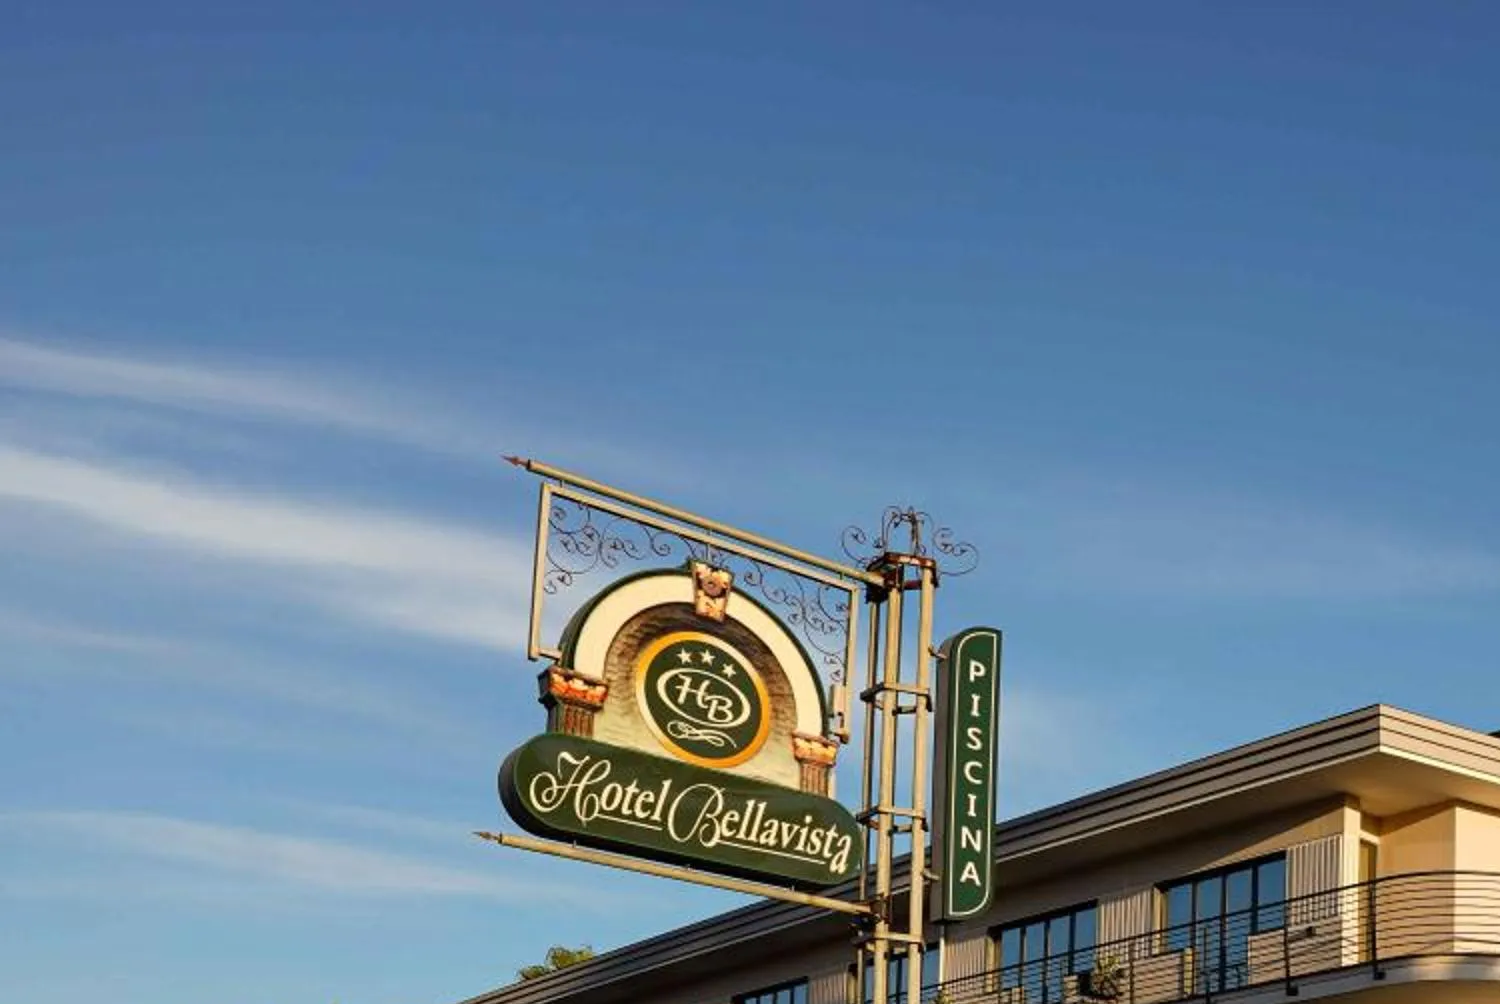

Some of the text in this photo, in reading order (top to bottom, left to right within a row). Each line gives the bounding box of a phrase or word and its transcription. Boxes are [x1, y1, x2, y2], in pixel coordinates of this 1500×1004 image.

[529, 752, 853, 876] Hotel Bellavista
[960, 658, 986, 887] PISCINA
